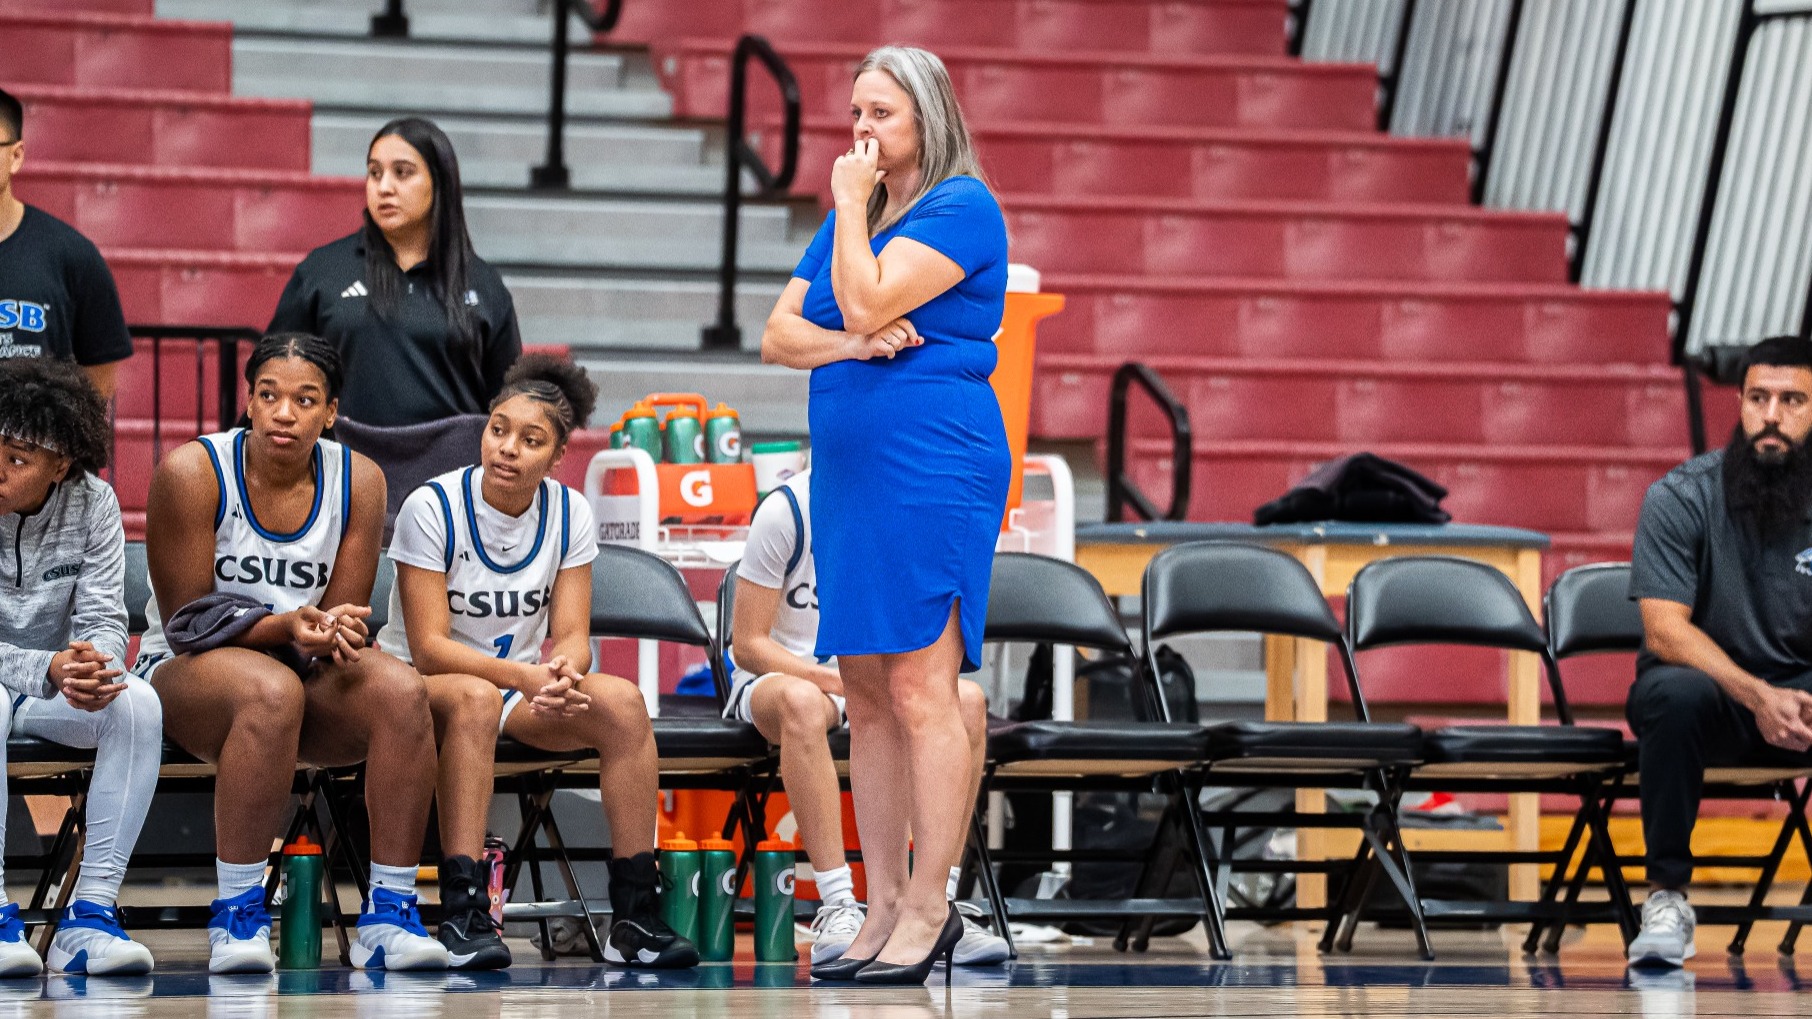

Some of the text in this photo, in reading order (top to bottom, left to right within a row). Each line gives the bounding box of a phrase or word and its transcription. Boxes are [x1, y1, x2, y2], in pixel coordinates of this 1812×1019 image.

[718, 430, 741, 458] G
[680, 469, 714, 507] G
[599, 521, 640, 540] GATORADE
[493, 633, 515, 659] 1
[776, 867, 796, 896] G
